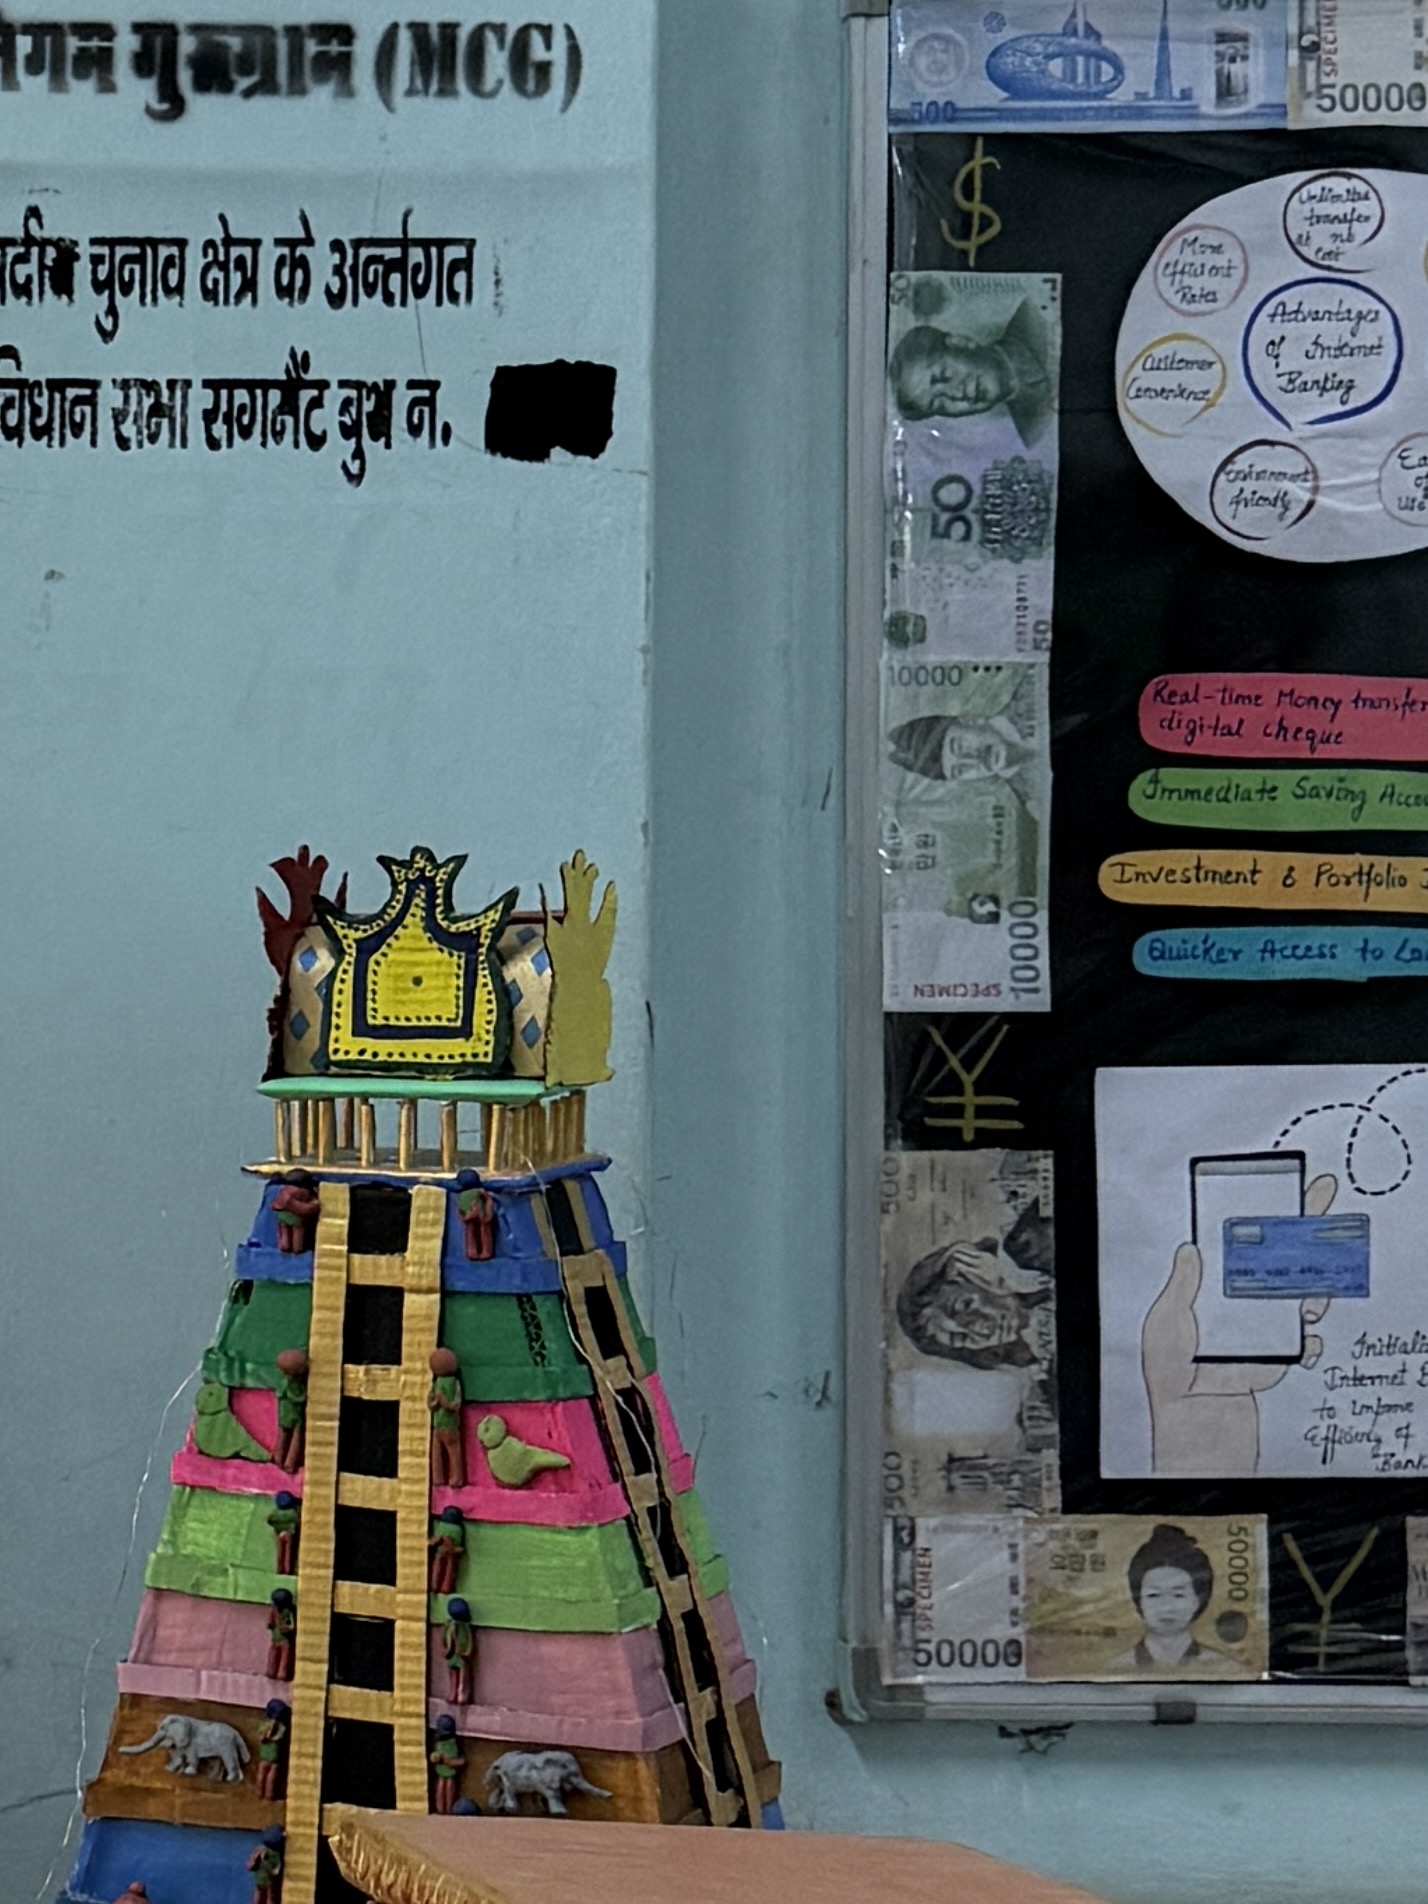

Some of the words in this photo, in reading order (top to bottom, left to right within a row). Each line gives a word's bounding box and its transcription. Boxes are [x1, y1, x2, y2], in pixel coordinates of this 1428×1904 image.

[373, 20, 583, 114] (MCG)
[1317, 83, 1427, 114] 50000
[88, 236, 188, 343] चुनाव
[199, 212, 262, 308] क्षेत्र
[272, 207, 315, 308] के
[1267, 300, 1380, 337] Advantages
[1275, 371, 1358, 405] Banking
[930, 473, 973, 544] 50
[886, 664, 963, 688] 10000
[1276, 689, 1343, 722] Money
[1159, 709, 1245, 745] digital
[1263, 716, 1344, 755] cheque
[1292, 776, 1367, 816] Saving
[1108, 855, 1262, 886] Investment
[1315, 862, 1408, 903] Portfolio
[1009, 899, 1042, 996] 10000
[1259, 939, 1339, 963] Access
[1355, 937, 1384, 963] to
[913, 982, 1002, 998] SPECIMEN
[1313, 1397, 1337, 1420] to
[913, 1638, 1024, 1669] 50000
